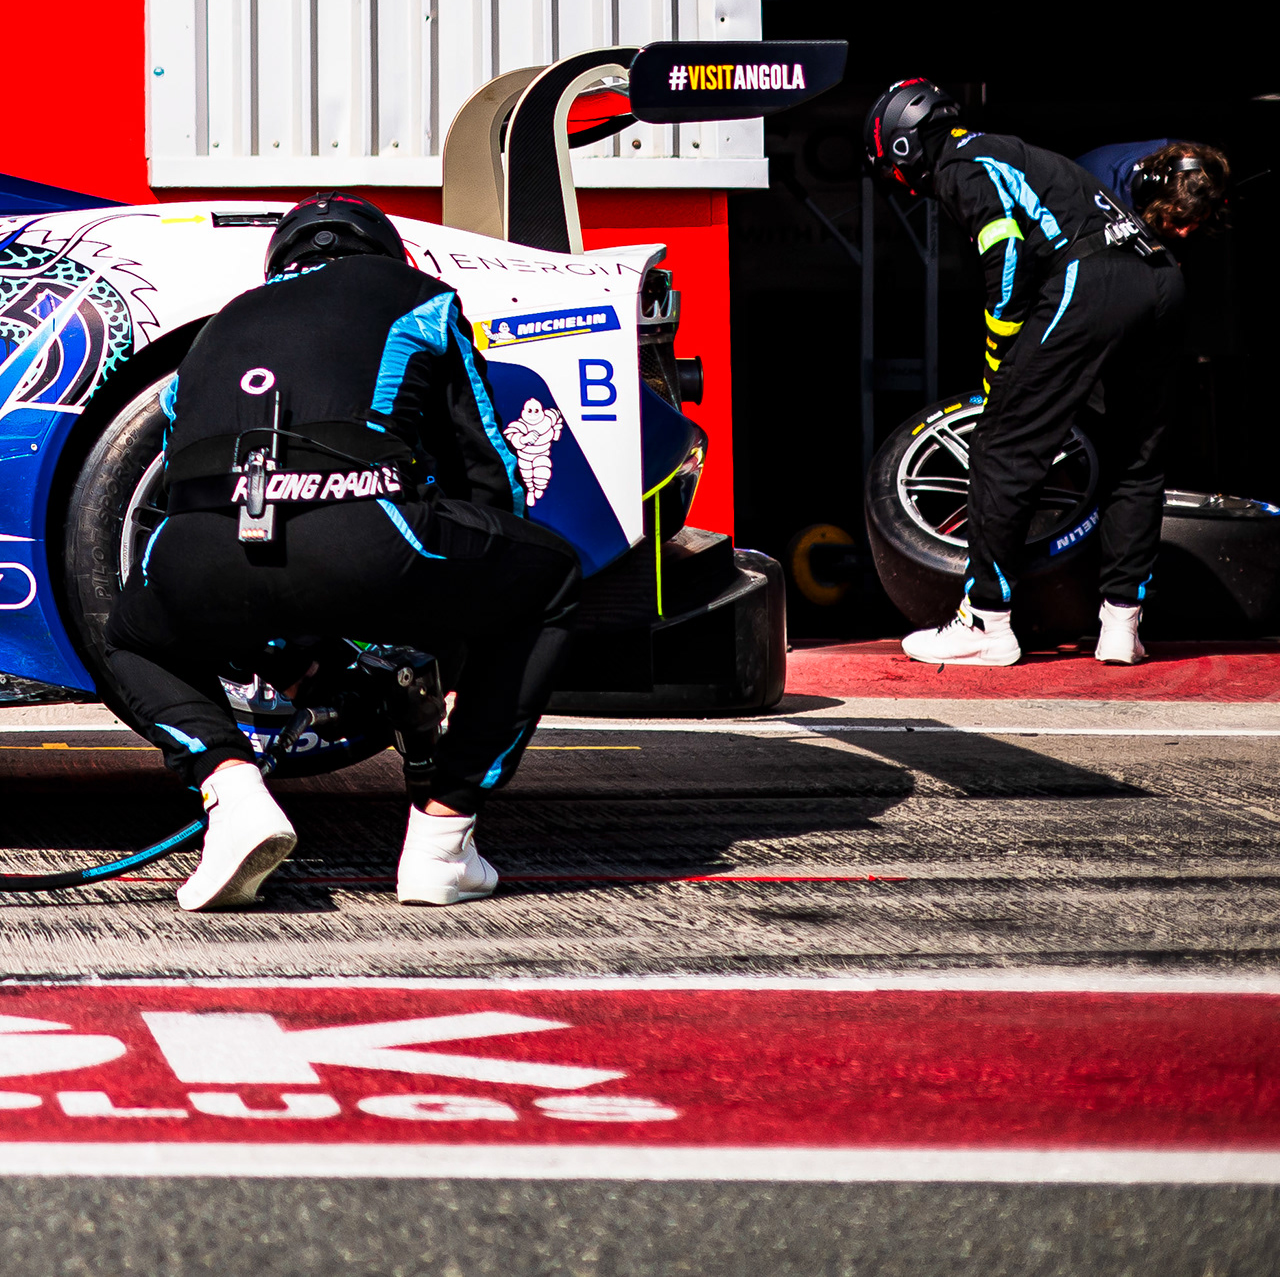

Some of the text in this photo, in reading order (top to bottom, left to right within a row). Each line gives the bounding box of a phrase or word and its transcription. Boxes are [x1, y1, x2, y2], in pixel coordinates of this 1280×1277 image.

[669, 64, 805, 91] #VISITANGOLA
[517, 313, 607, 336] MICHELIN
[578, 359, 618, 407] B
